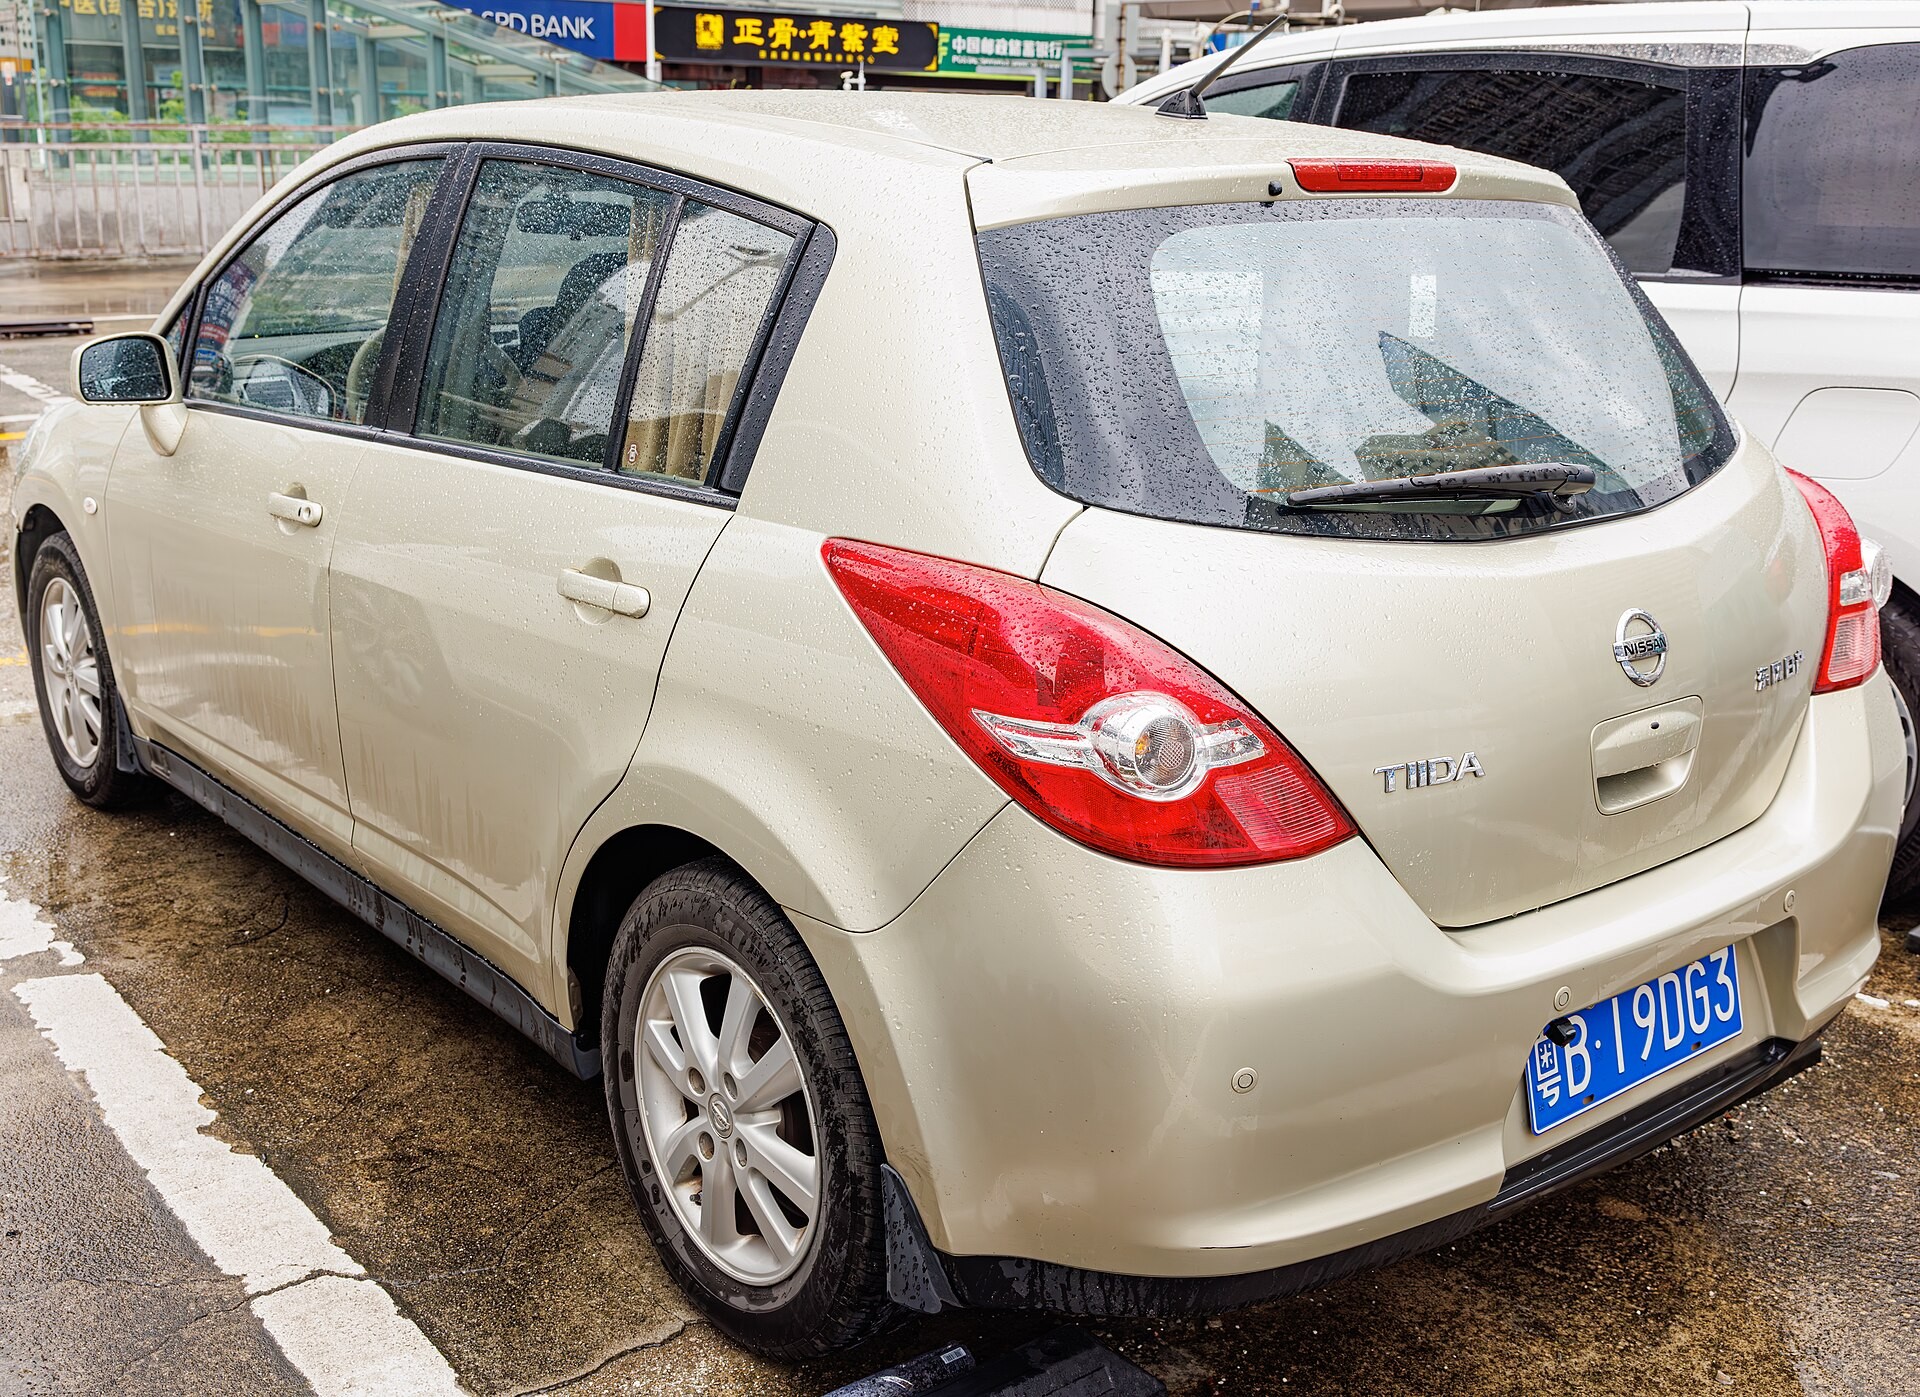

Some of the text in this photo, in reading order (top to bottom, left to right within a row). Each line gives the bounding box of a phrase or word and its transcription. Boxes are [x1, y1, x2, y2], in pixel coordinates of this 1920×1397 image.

[531, 14, 596, 39] BANK
[1623, 636, 1667, 657] NISSAN
[1373, 751, 1486, 794] TIIDA
